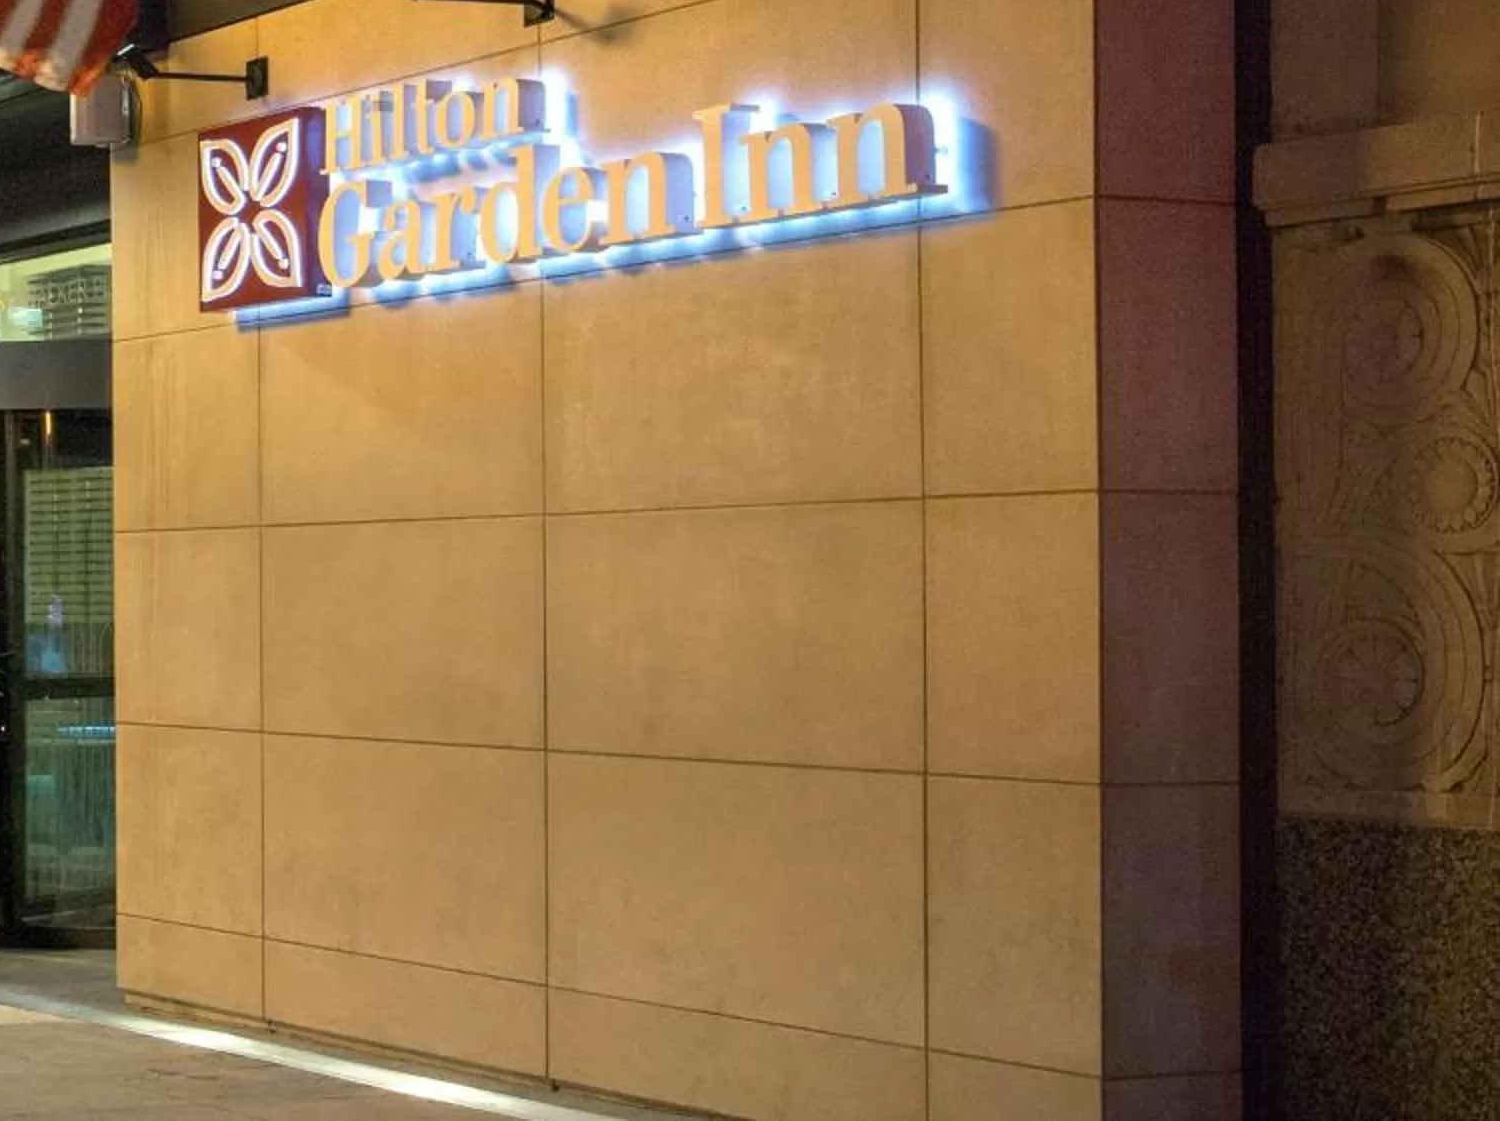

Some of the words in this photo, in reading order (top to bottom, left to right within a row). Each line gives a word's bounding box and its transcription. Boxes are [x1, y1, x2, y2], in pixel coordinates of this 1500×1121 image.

[318, 143, 686, 288] Garden
[692, 102, 930, 229] Inn
[319, 76, 540, 176] Hilton
